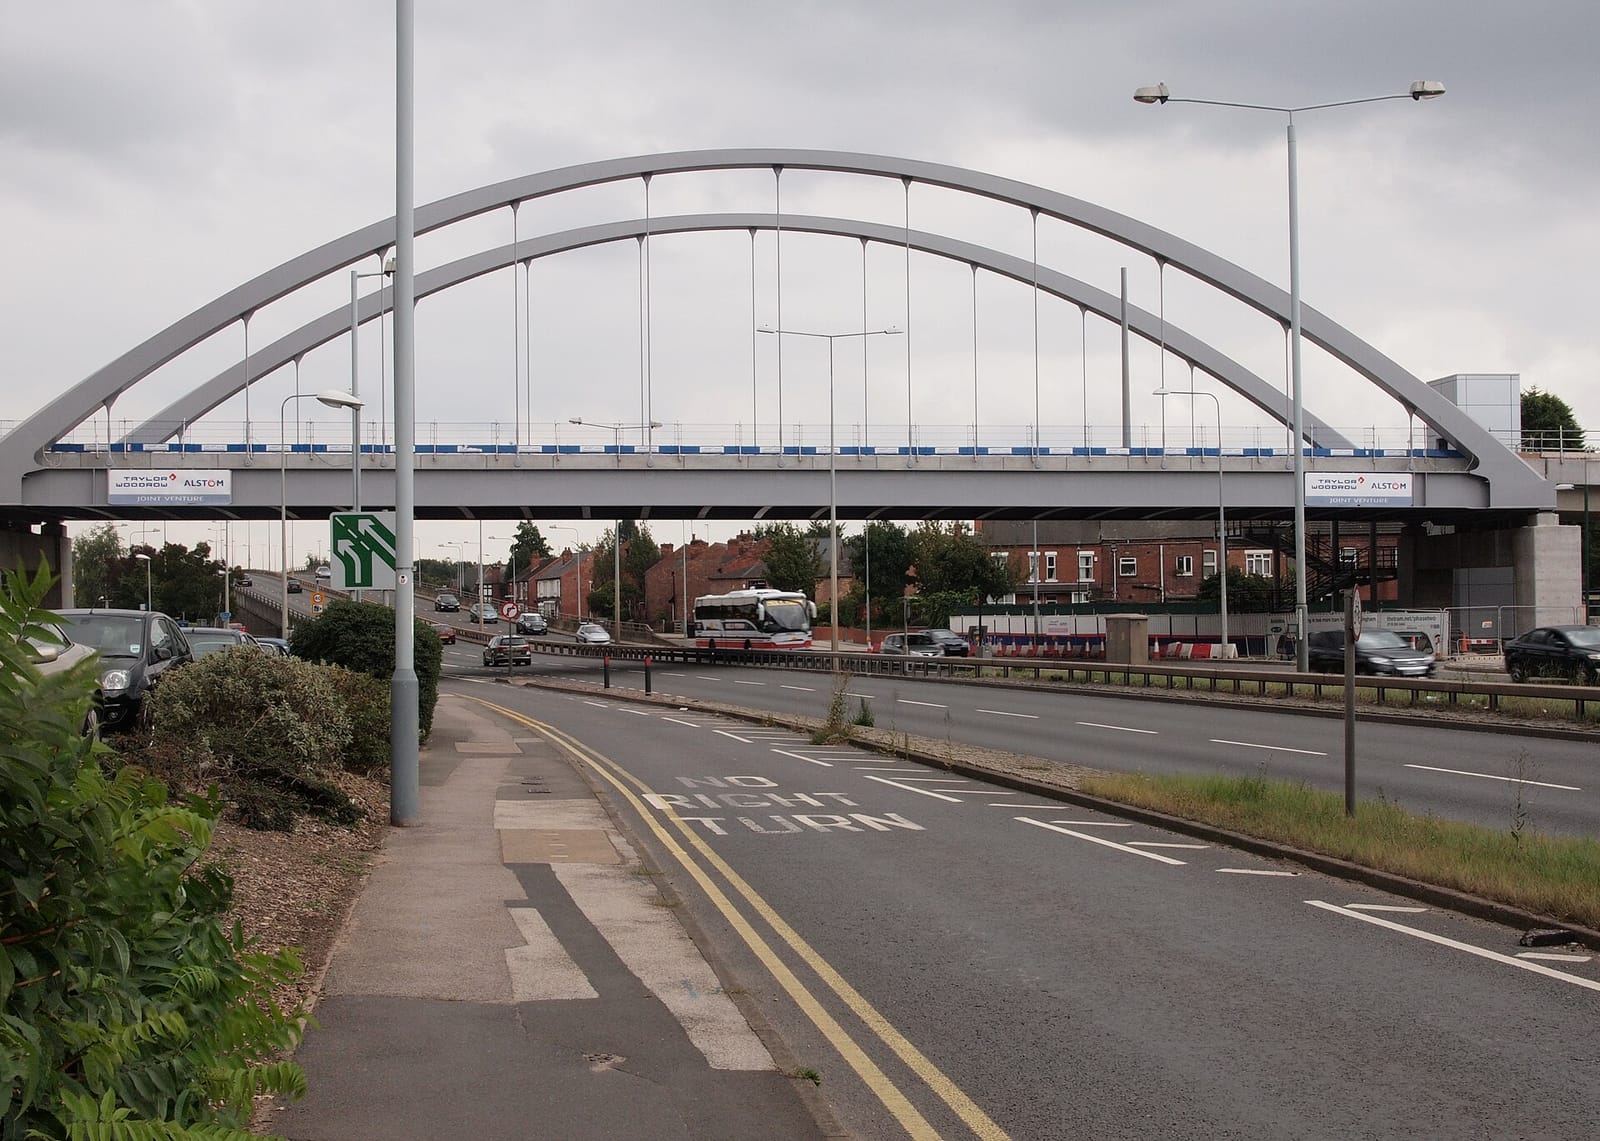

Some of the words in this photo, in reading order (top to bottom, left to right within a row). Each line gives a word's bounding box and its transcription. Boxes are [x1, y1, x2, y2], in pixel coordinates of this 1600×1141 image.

[675, 775, 778, 788] NO
[642, 792, 860, 810] RIGHT
[669, 812, 927, 835] TURN
